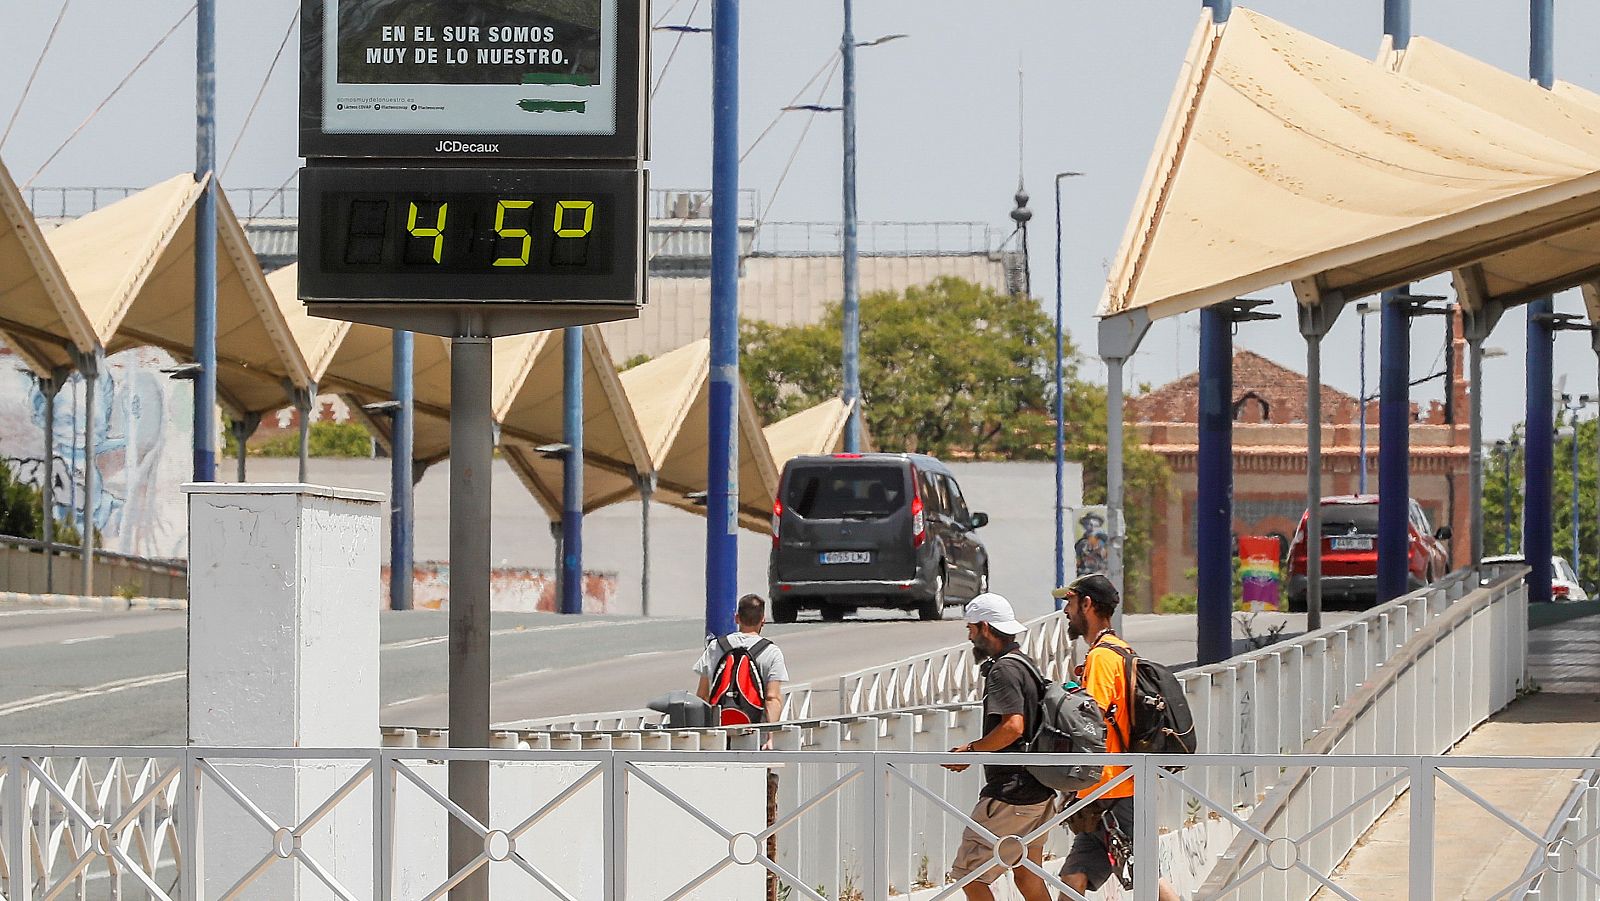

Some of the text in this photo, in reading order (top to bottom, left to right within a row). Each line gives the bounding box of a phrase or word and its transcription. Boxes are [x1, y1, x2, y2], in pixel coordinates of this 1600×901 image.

[382, 26, 555, 42] EN EL SUR SOMOS
[366, 48, 569, 65] MUY DE LO NUESTRO.
[435, 140, 499, 153] JCDecaux
